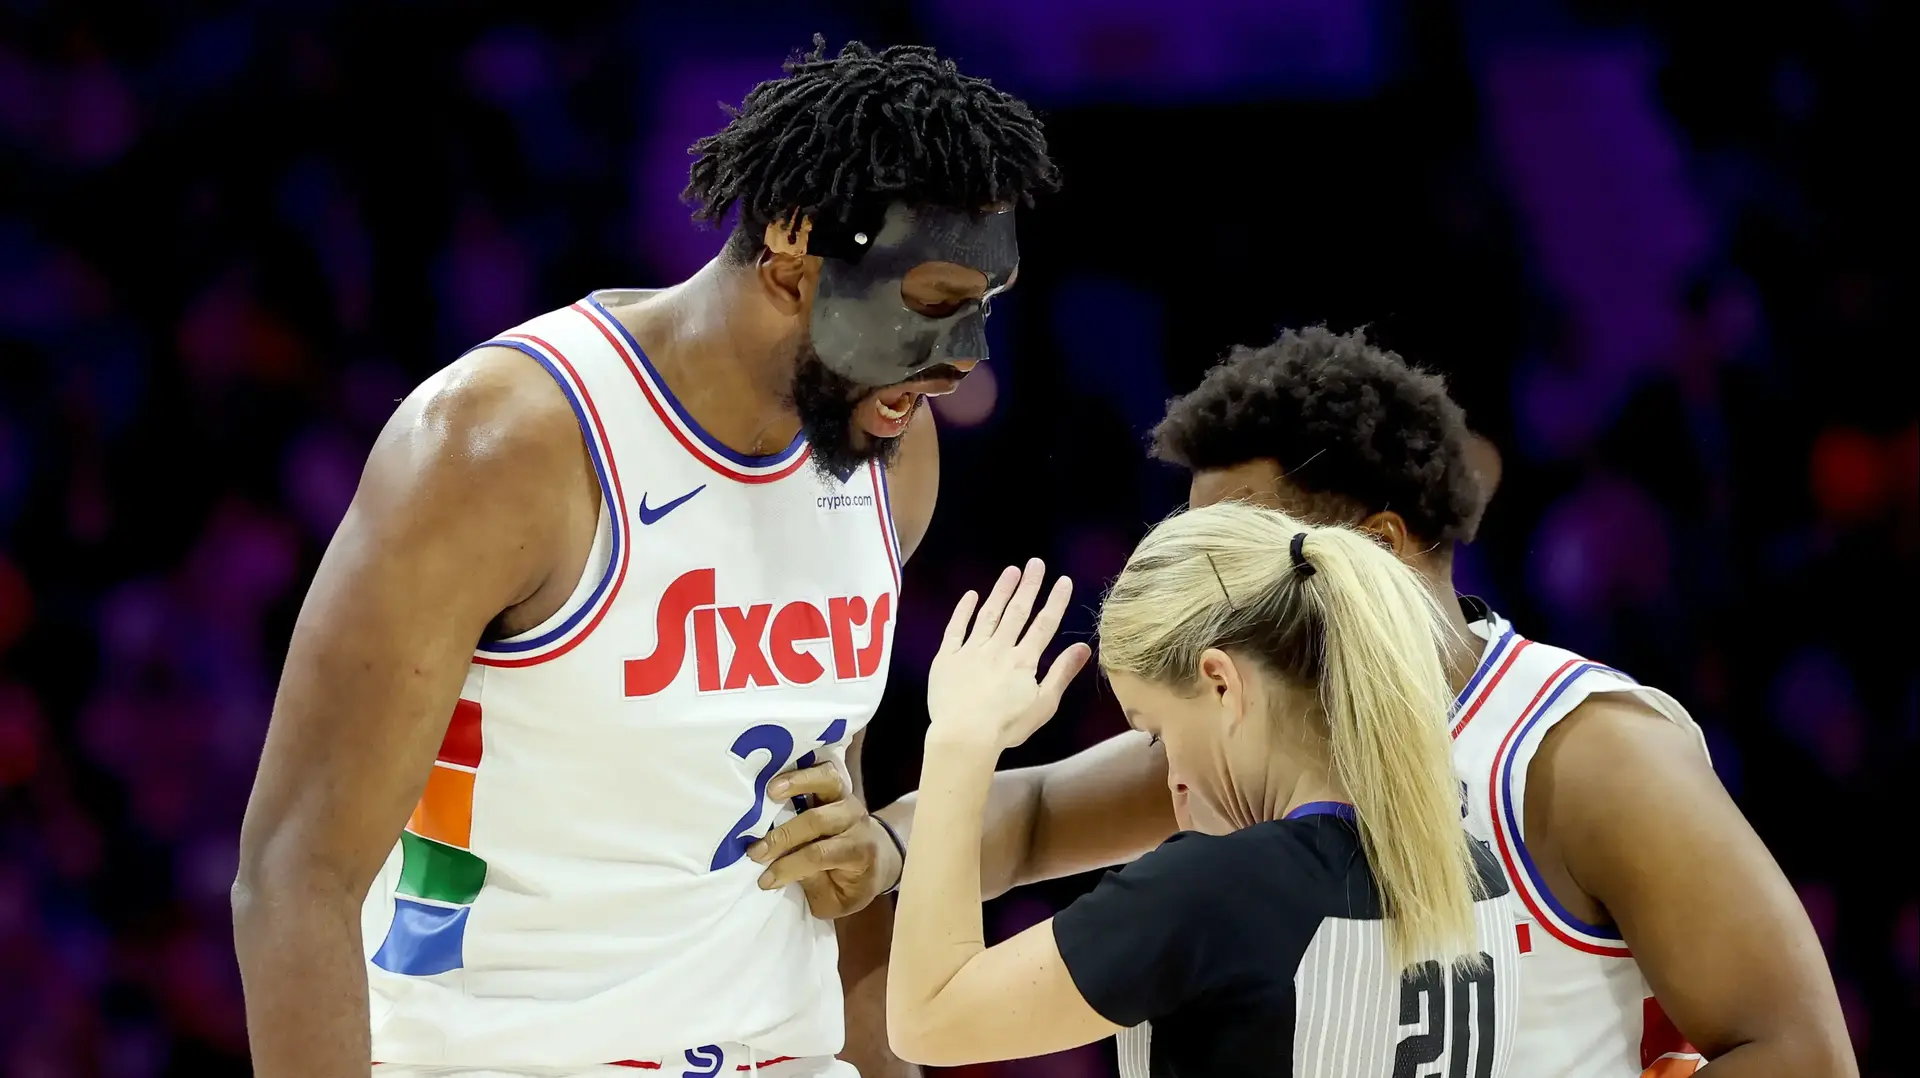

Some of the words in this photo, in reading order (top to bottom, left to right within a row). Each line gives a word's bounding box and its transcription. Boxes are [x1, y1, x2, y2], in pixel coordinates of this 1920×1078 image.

[816, 494, 873, 510] crypto.com
[623, 567, 891, 698] Sixers
[1392, 950, 1496, 1078] 20
